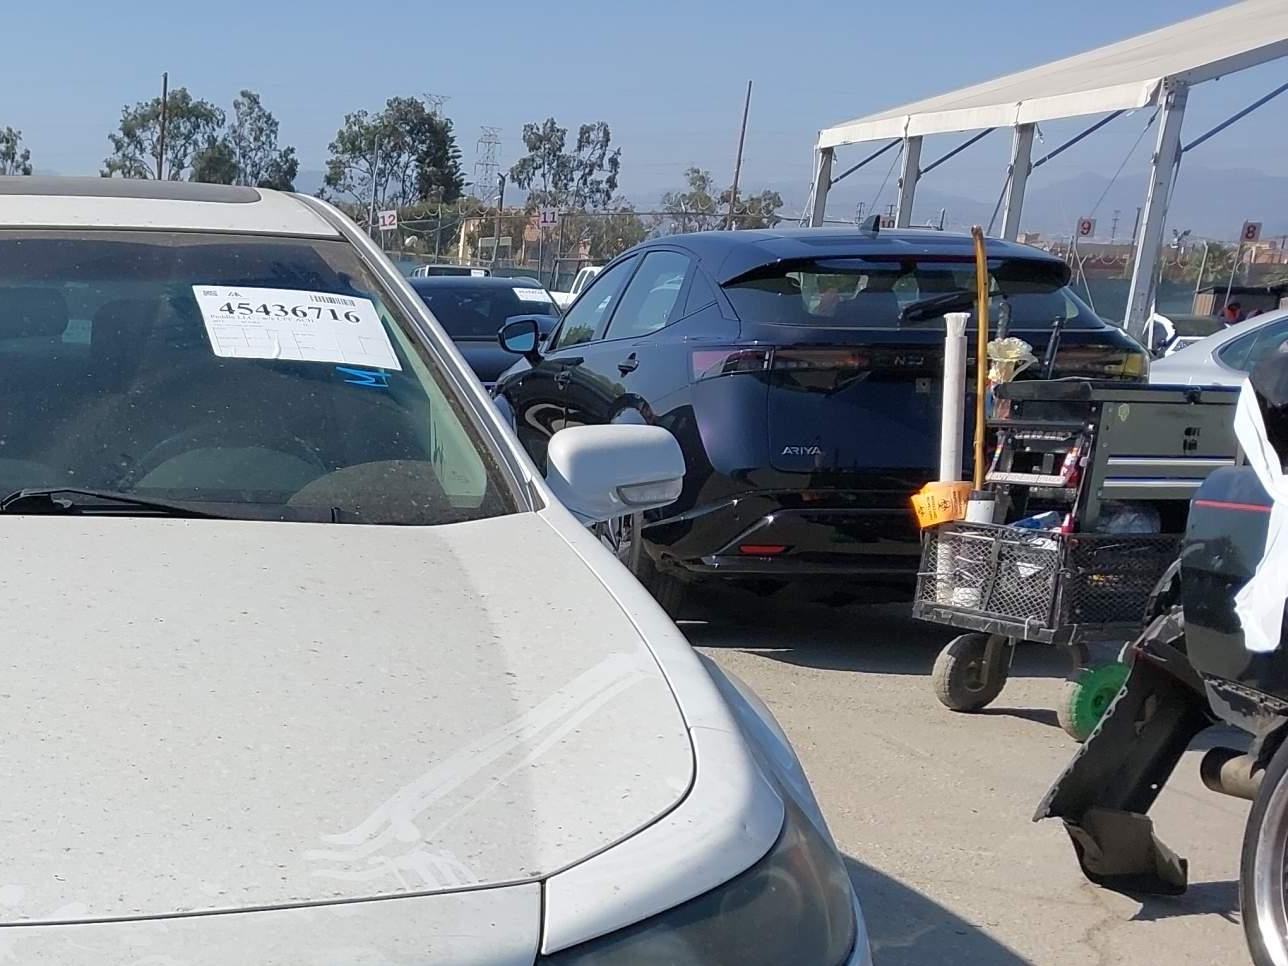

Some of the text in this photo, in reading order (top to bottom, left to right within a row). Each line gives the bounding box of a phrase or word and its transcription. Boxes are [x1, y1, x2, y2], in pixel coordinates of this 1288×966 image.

[380, 214, 396, 226] 12
[541, 211, 557, 224] 11
[1080, 220, 1091, 235] 9
[1245, 225, 1257, 240] 8
[218, 302, 362, 324] 45436716
[781, 446, 822, 456] ARIYA
